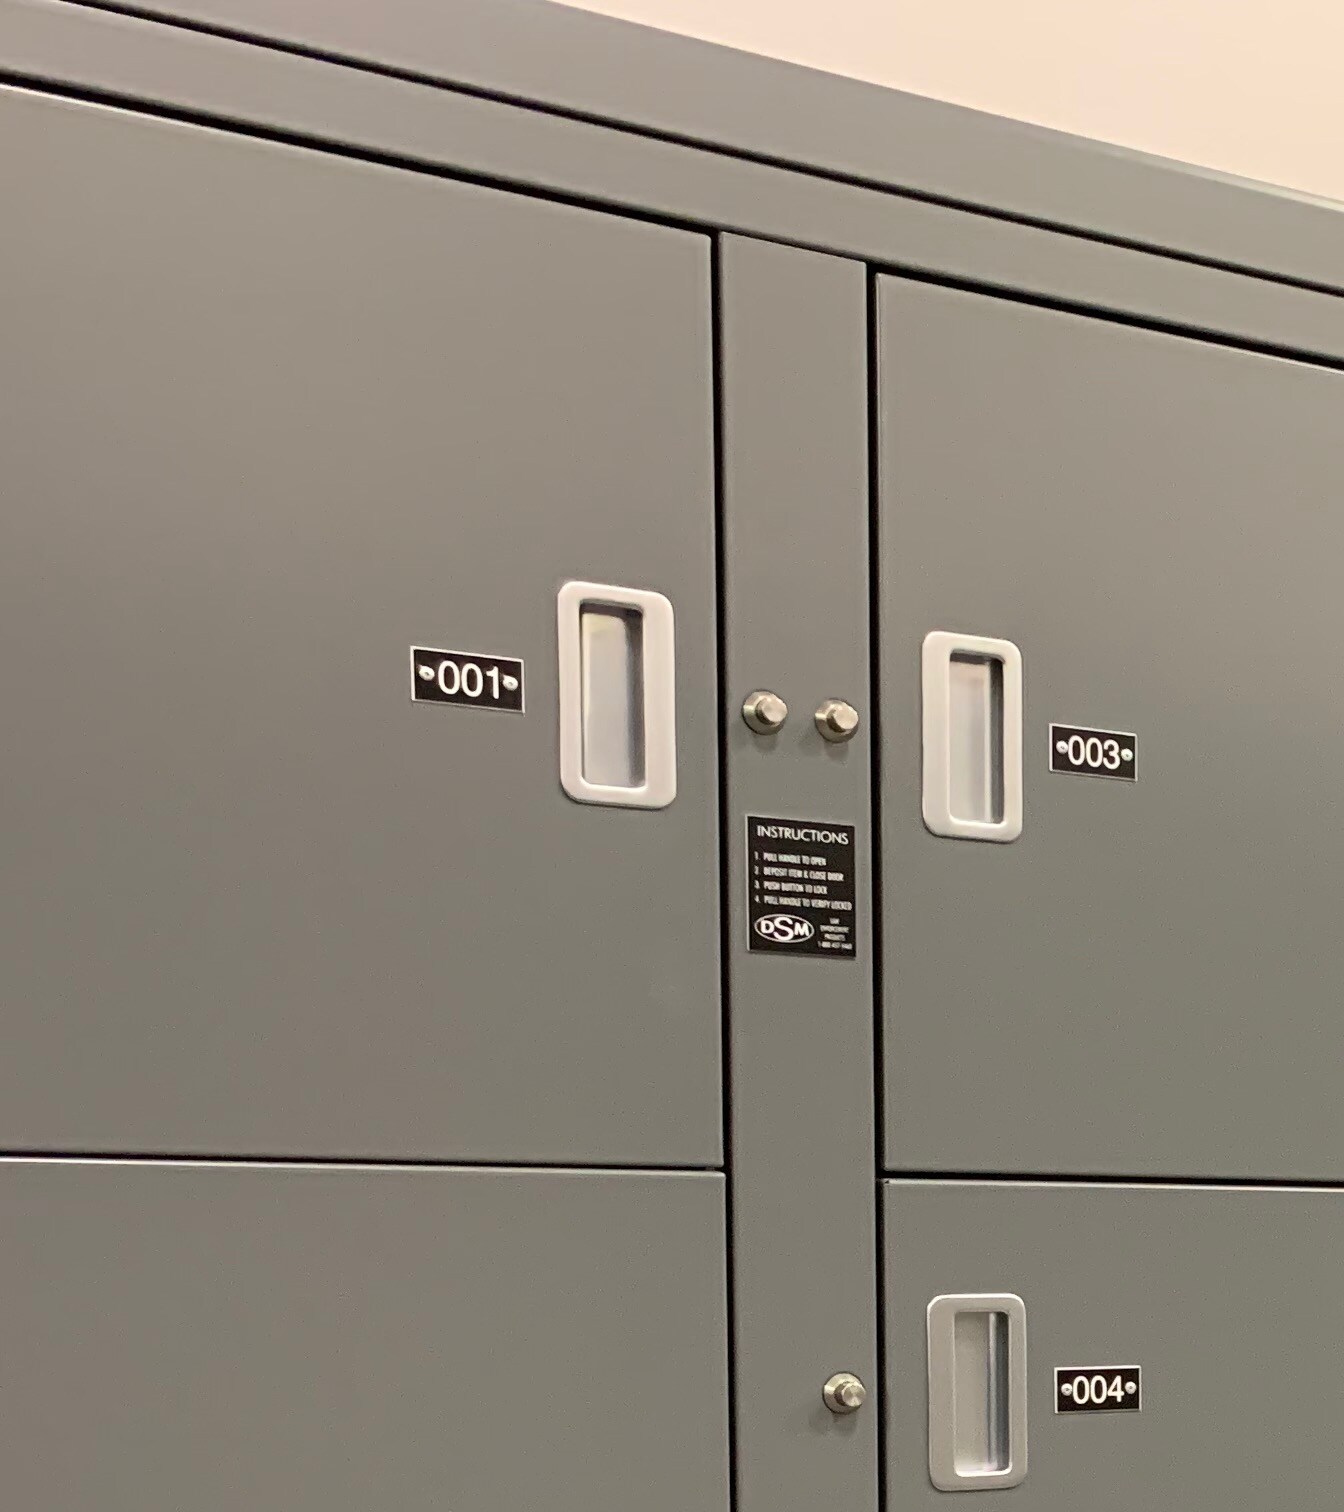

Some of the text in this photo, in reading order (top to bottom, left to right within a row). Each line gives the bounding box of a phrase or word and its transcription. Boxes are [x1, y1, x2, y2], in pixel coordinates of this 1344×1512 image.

[437, 660, 500, 698] 001
[1068, 735, 1121, 768] 003
[757, 825, 849, 845] INSTRUCTIONS
[760, 916, 809, 941] DSM
[1072, 1375, 1124, 1404] 004
